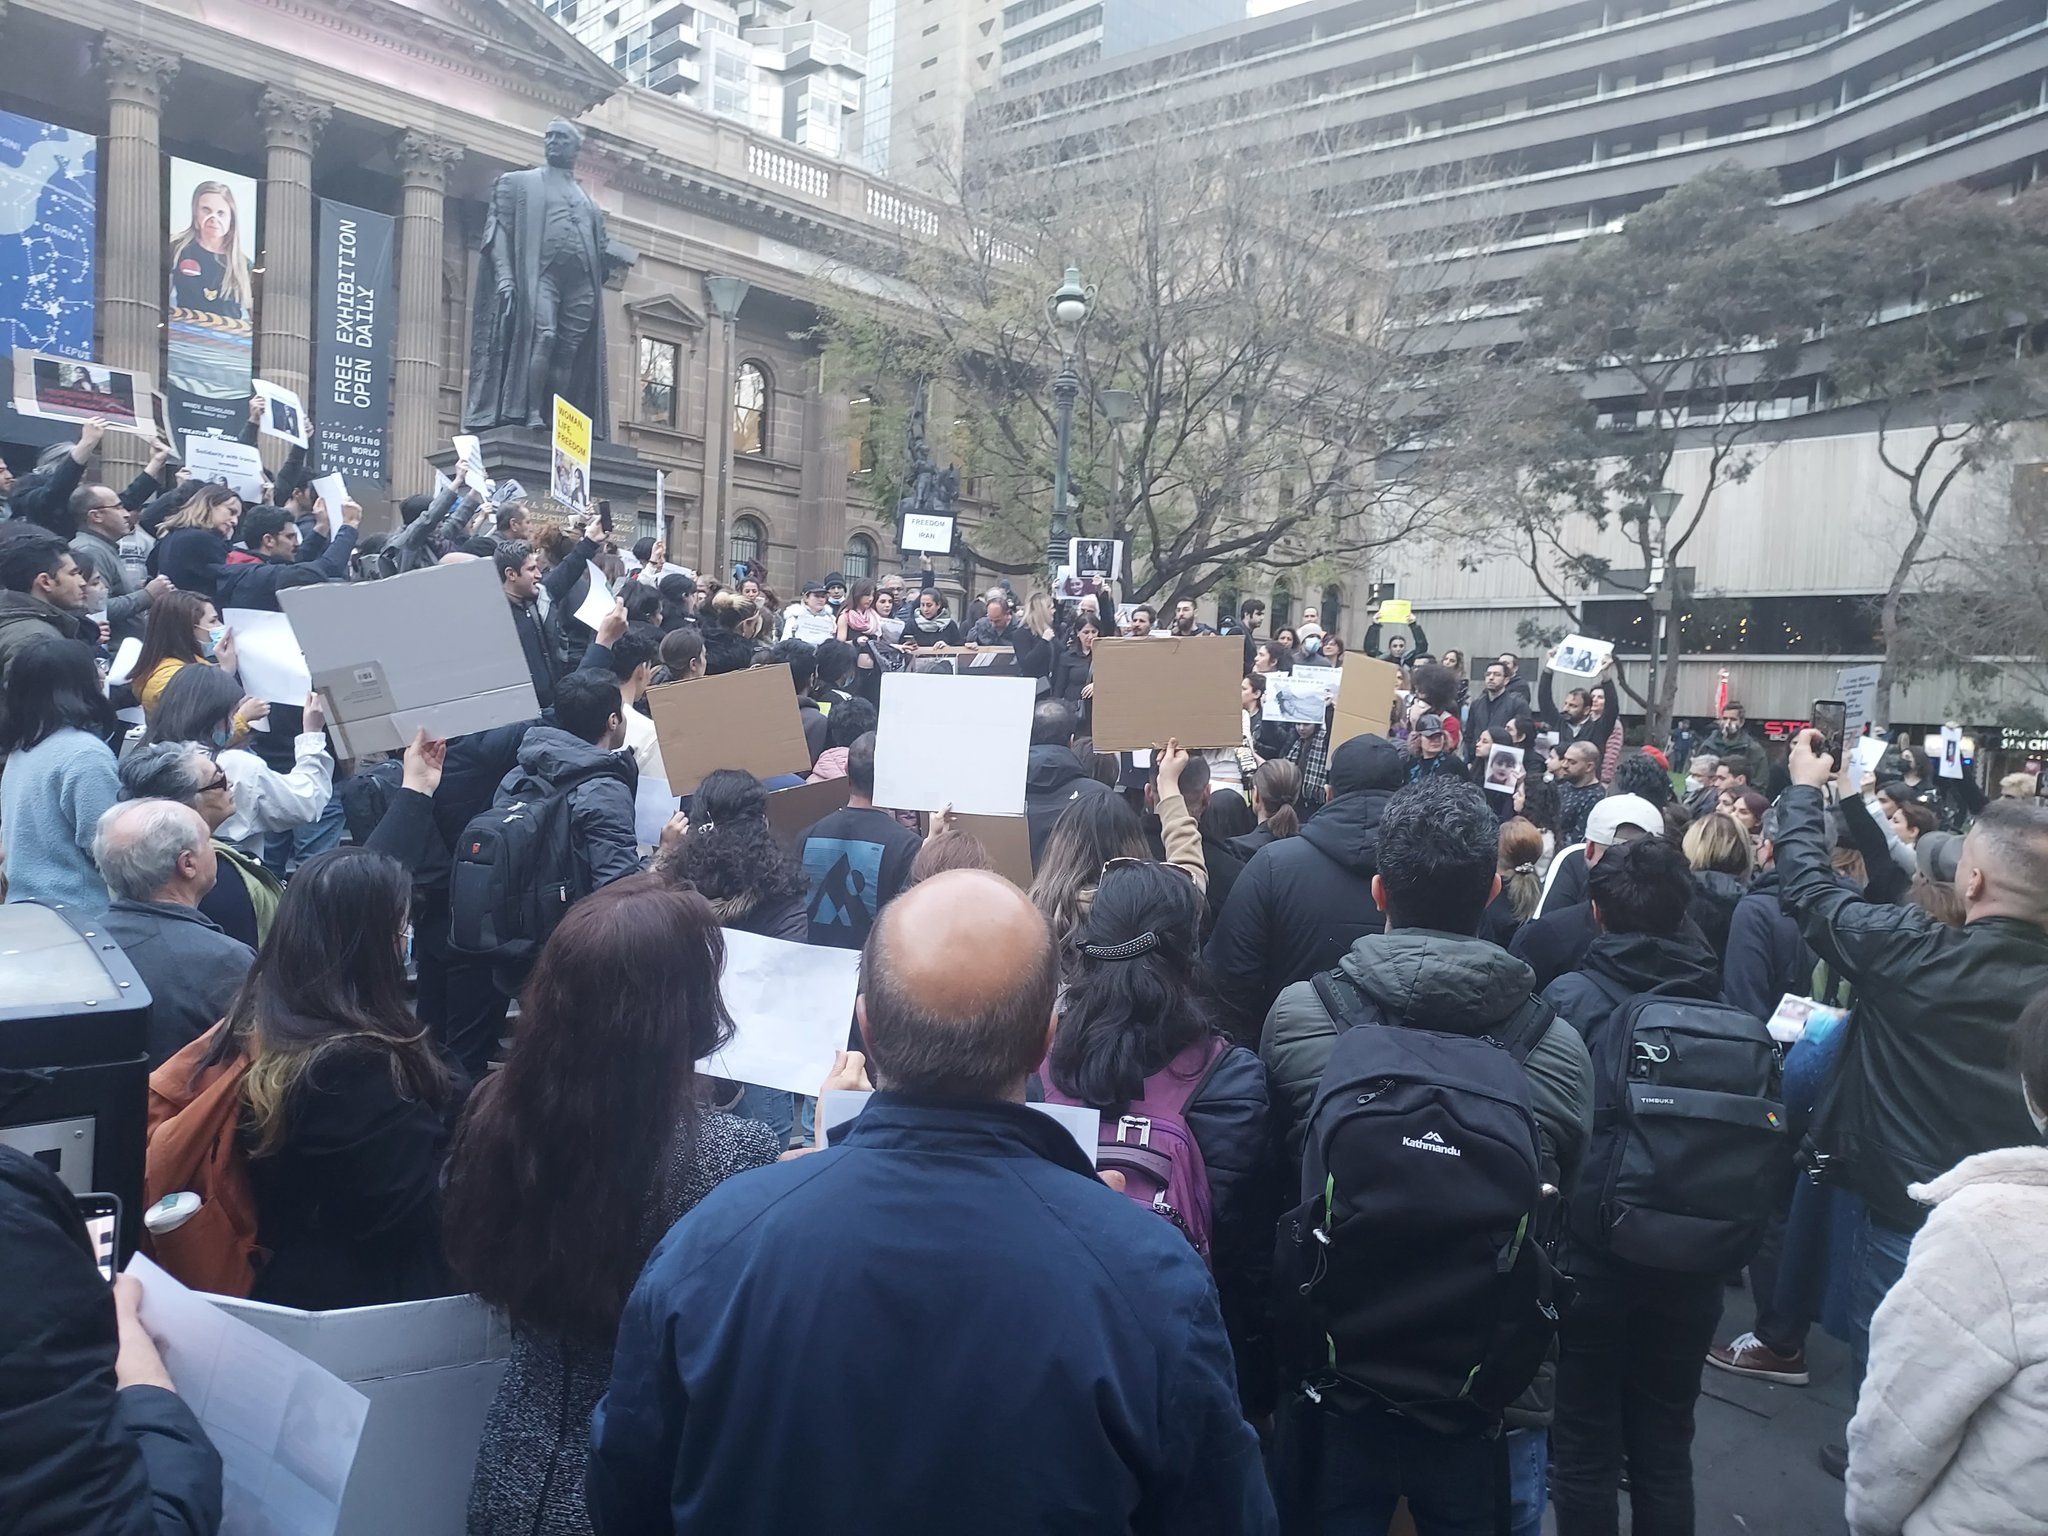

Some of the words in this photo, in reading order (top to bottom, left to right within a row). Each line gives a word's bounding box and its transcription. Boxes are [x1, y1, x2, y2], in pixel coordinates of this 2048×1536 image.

[42, 222, 78, 241] ORION
[336, 219, 357, 343] EXHIBITION
[355, 284, 375, 349] DAILY
[59, 344, 91, 360] LEPUS
[334, 355, 352, 404] FREE
[353, 358, 373, 409] OPEN
[321, 430, 381, 447] EXPLORING
[557, 432, 586, 456] FREEDOM
[321, 441, 340, 452] THE
[351, 446, 381, 458] WORLD
[321, 452, 380, 469] THROUGH
[320, 463, 380, 480] MAKING
[911, 518, 946, 528] FREEDOM
[918, 531, 936, 540] IRAN
[1640, 1097, 1674, 1105] TIMBUK2
[1402, 1136, 1461, 1157] Kathmandu
